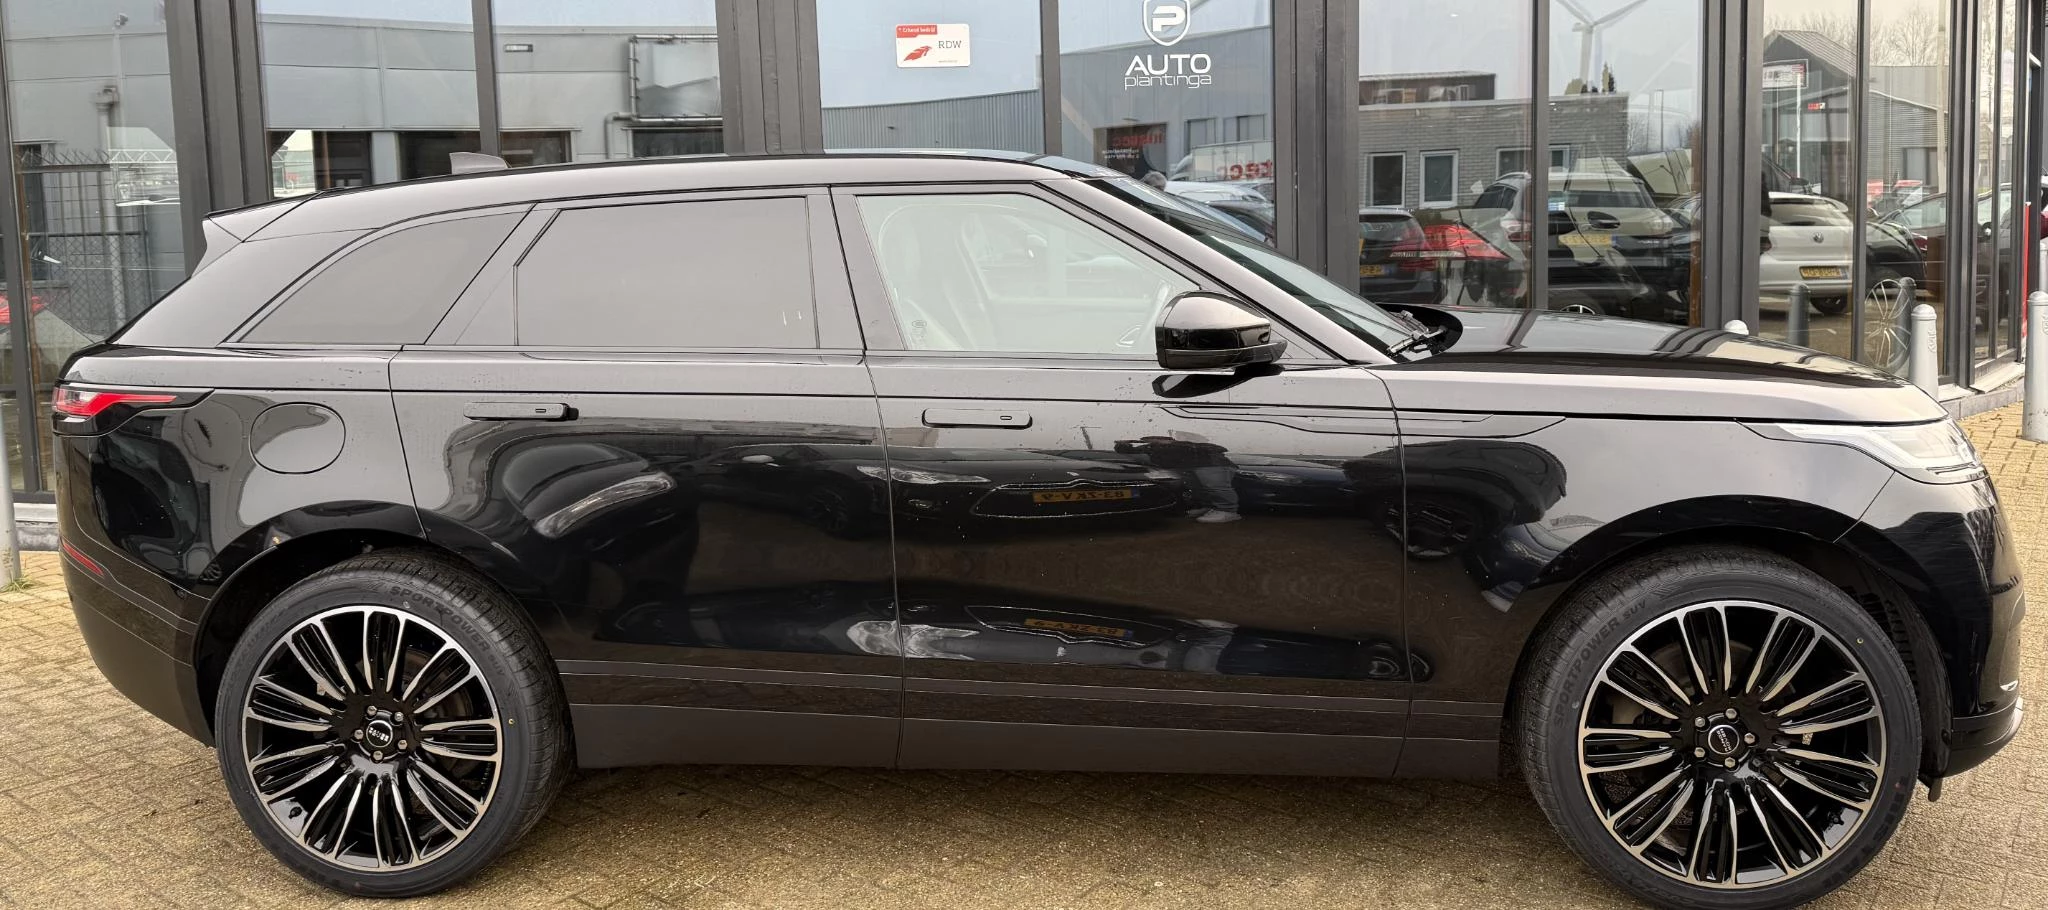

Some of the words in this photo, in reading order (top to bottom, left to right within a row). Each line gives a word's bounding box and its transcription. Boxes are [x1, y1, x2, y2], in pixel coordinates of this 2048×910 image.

[1152, 5, 1186, 32] P
[938, 40, 962, 49] RDW
[1125, 53, 1212, 76] AUTO
[1125, 74, 1212, 91] plantinga
[390, 585, 491, 652] SPORTPOWER
[1553, 616, 1620, 728] SPORTPOWER
[1622, 599, 1646, 620] SUV
